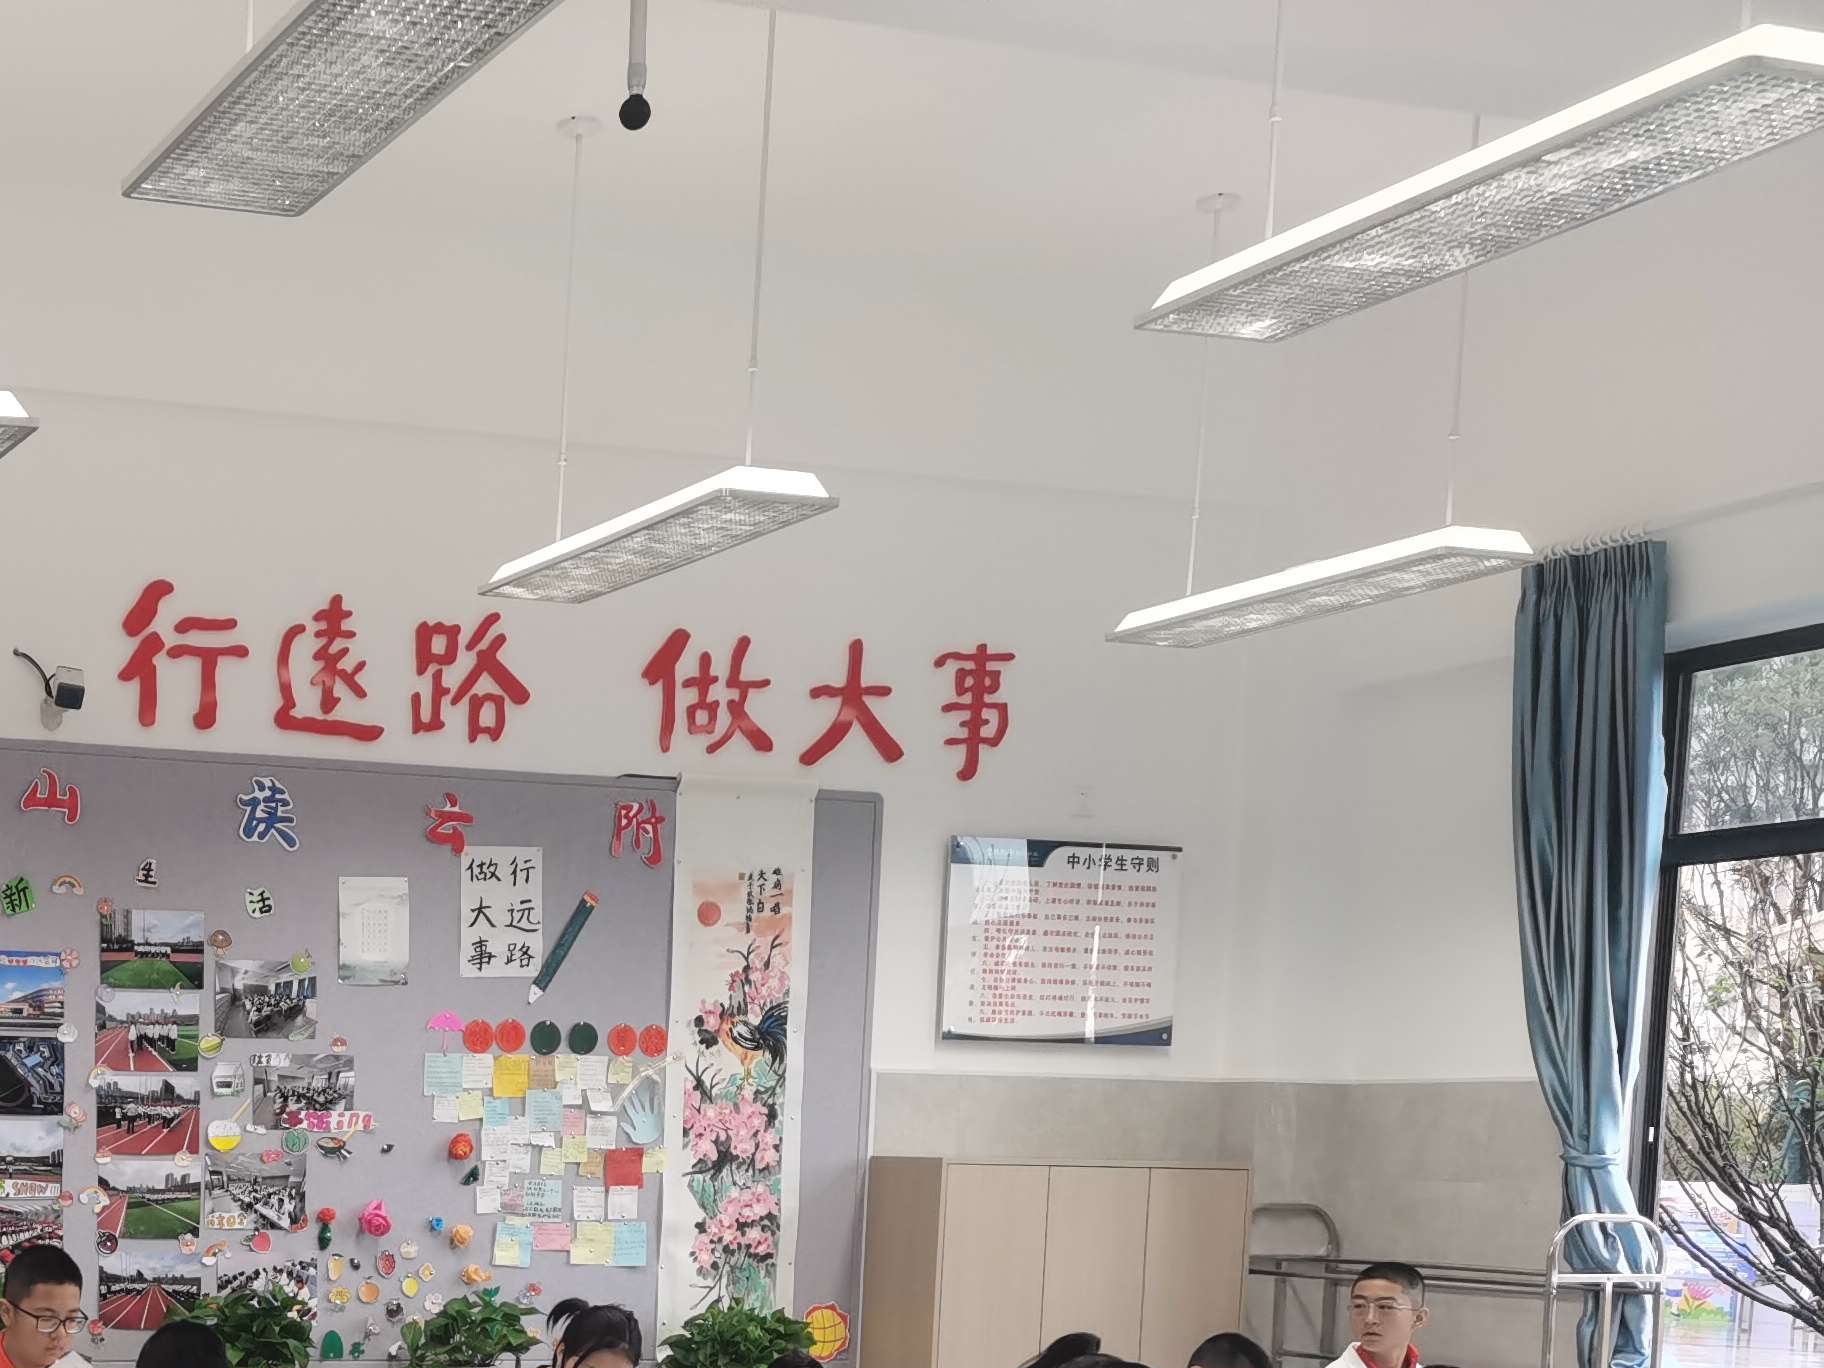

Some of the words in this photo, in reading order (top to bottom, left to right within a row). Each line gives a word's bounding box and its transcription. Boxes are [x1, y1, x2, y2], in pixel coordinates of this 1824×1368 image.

[643, 630, 1015, 780] 做大事
[1066, 853, 1161, 873] 中小学生守则
